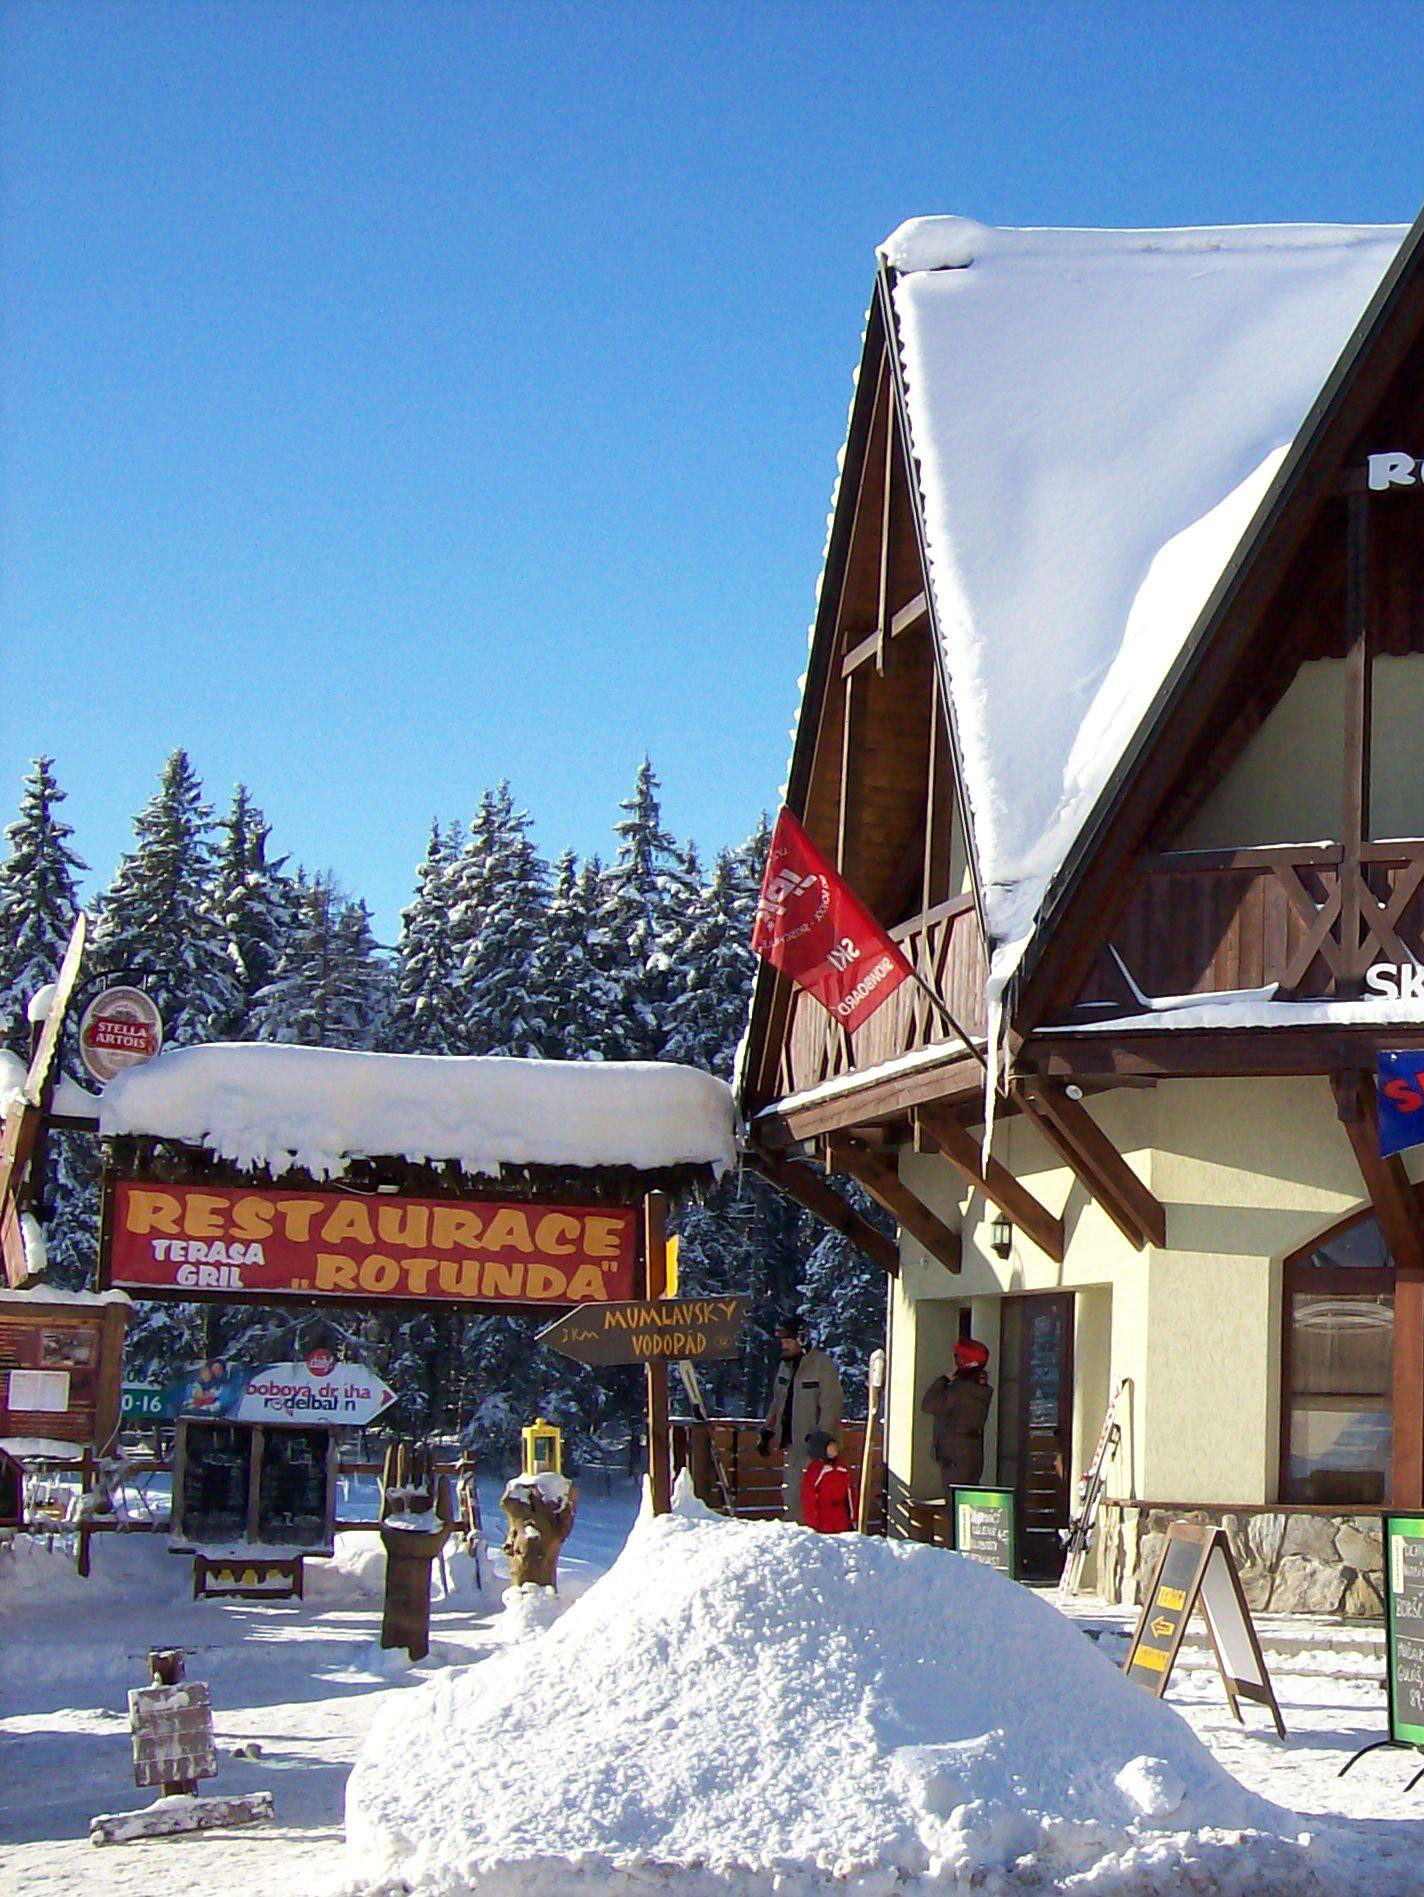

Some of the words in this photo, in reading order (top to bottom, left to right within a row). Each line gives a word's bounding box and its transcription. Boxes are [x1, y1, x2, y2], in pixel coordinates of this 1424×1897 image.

[95, 1033, 145, 1049] ARTOIS
[97, 1020, 147, 1038] STELLA
[126, 1189, 627, 1258] RESTAURACE
[152, 1238, 266, 1266] TERASA
[175, 1264, 244, 1289] GRIL
